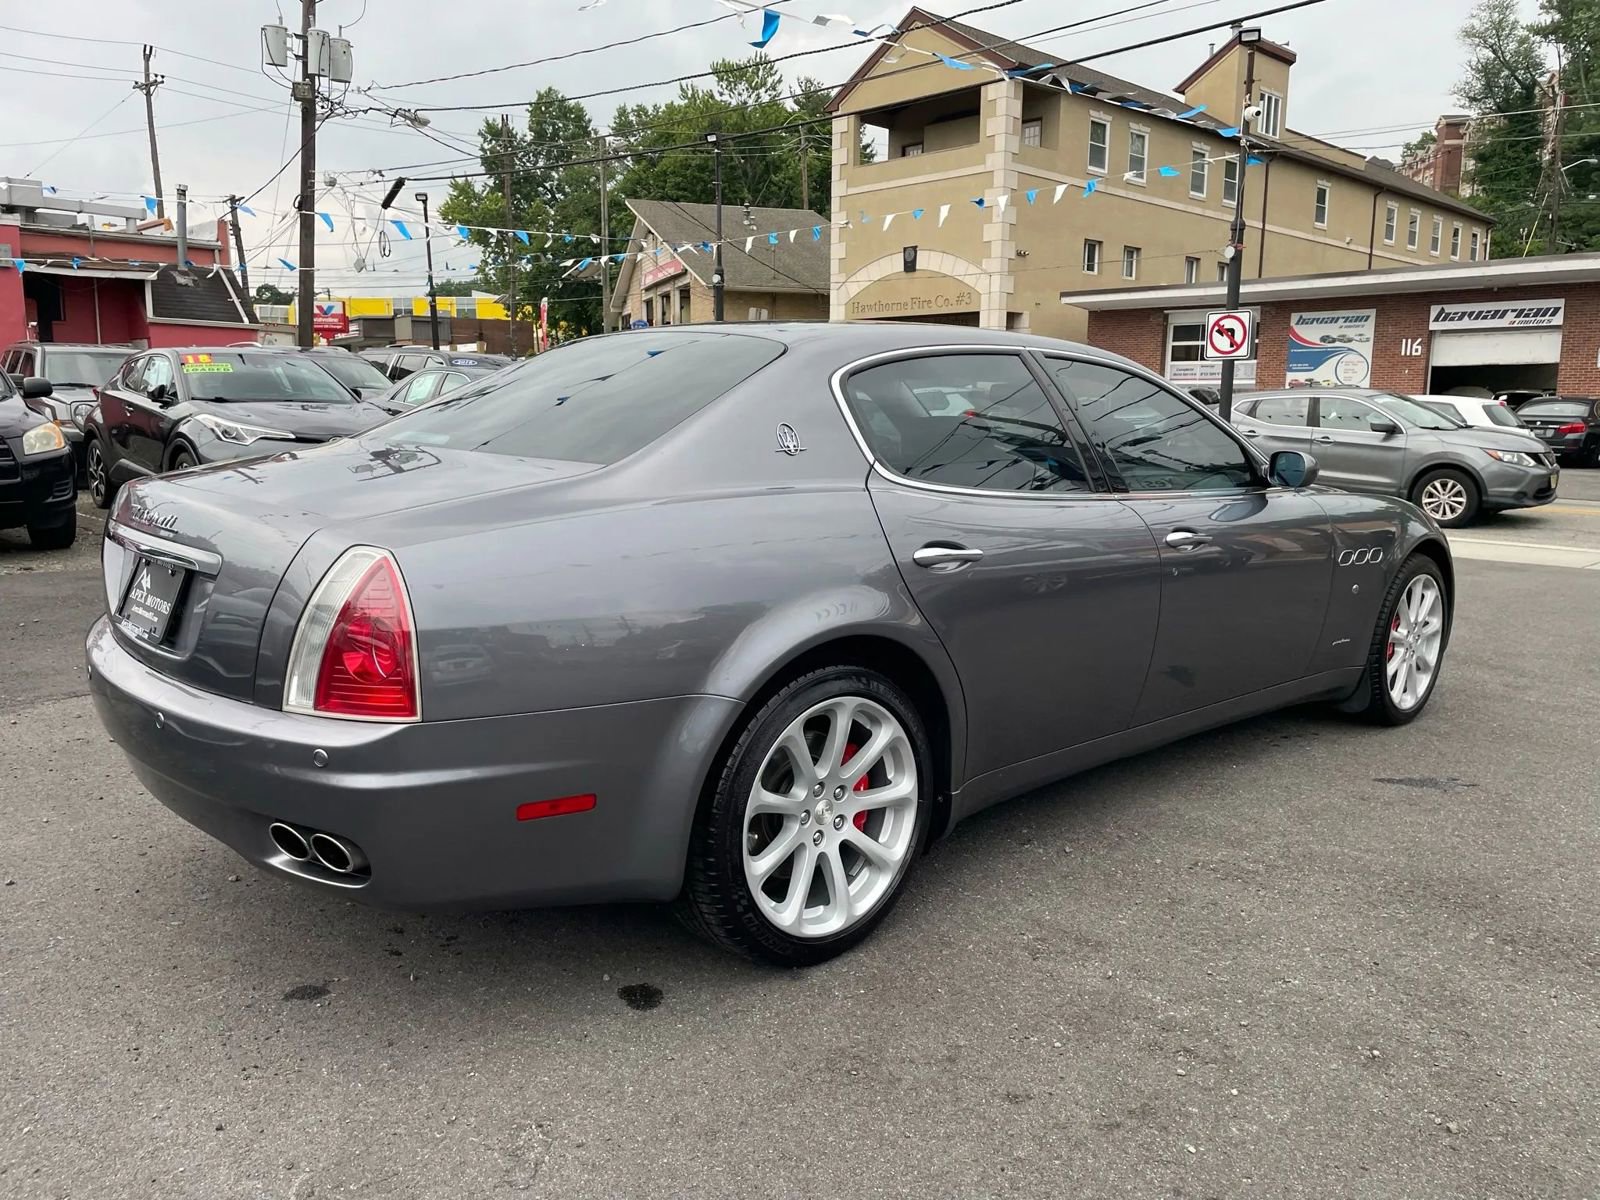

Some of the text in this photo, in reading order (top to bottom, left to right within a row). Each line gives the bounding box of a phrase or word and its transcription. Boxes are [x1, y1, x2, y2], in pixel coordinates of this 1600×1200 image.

[852, 292, 973, 314] Hawthorne Fire Co. #3
[1295, 314, 1371, 326] bavarian
[1432, 306, 1562, 323] bavarian
[1517, 318, 1554, 326] motors
[1401, 338, 1422, 356] 116
[130, 588, 172, 615] APEX MOTORS
